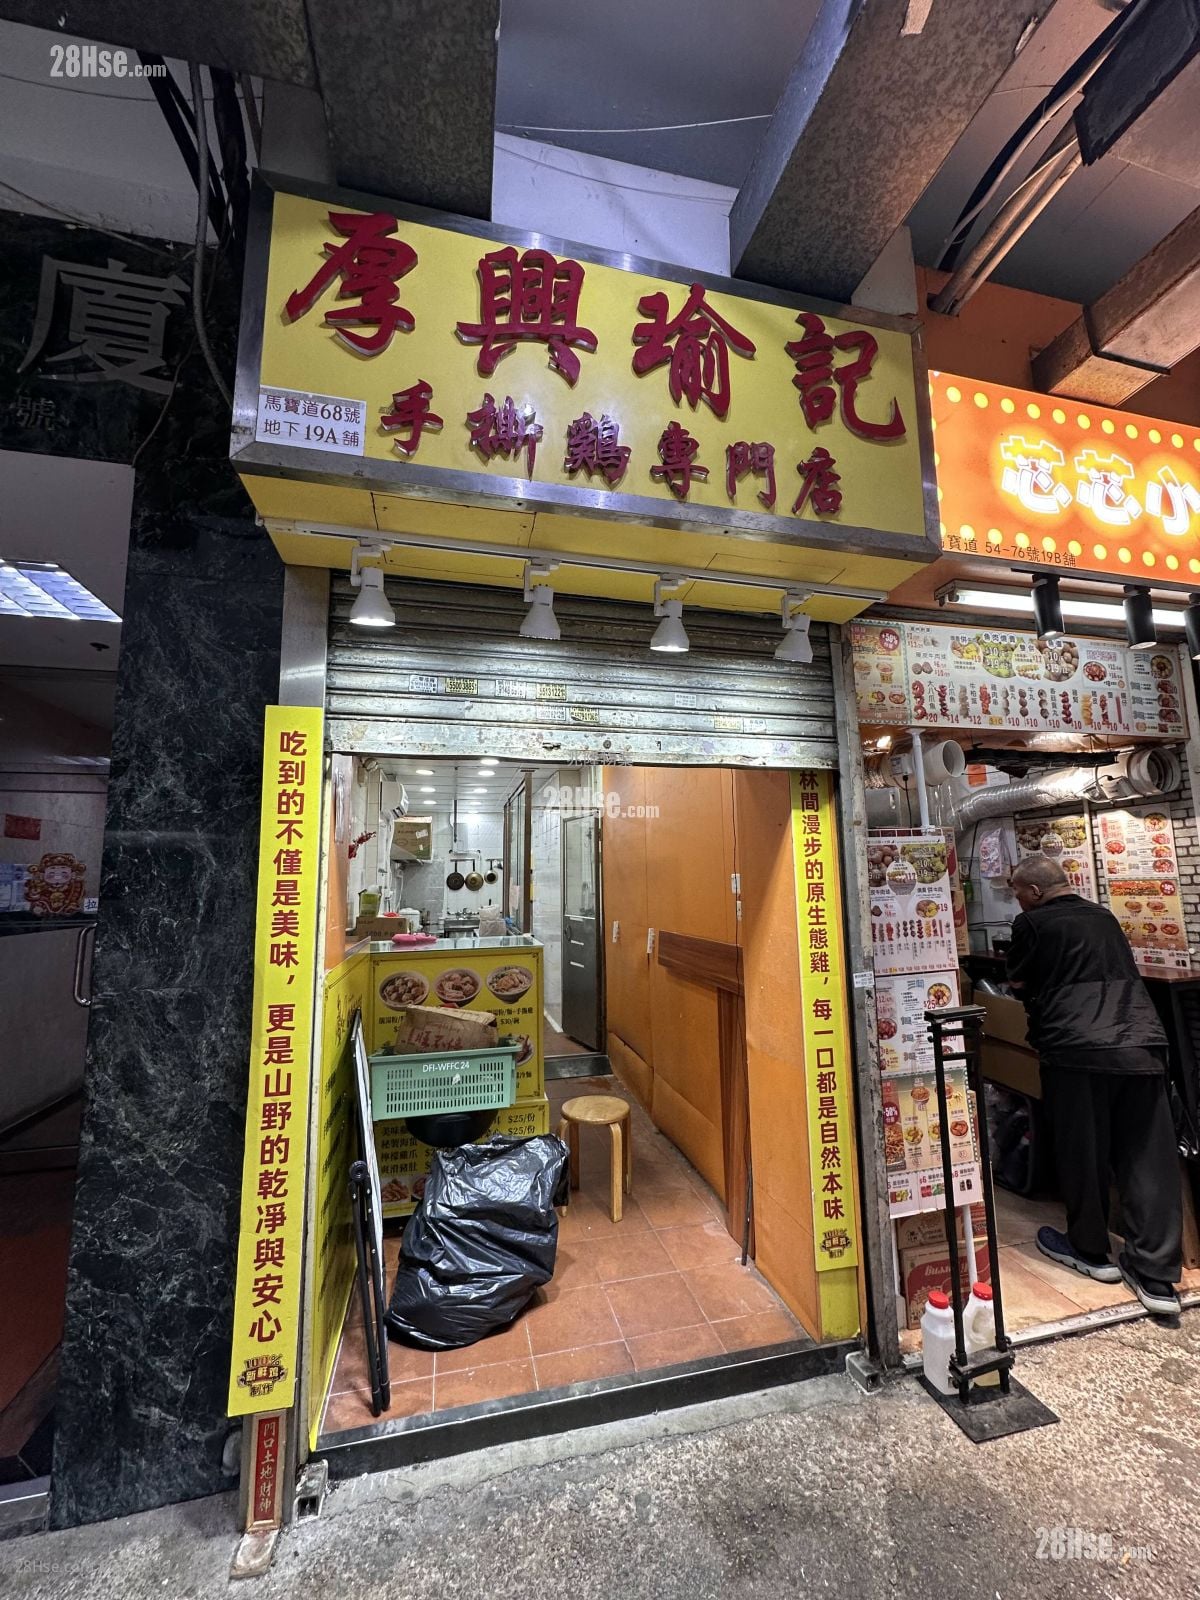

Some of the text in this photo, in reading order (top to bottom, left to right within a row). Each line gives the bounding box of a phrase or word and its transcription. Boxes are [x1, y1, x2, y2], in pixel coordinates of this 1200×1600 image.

[16, 255, 192, 395] 廈
[264, 394, 361, 425] 馬寶道68號
[508, 1112, 535, 1123] $25/份
[508, 1125, 535, 1136] $25/份
[258, 1421, 277, 1514] 門口土地財神
